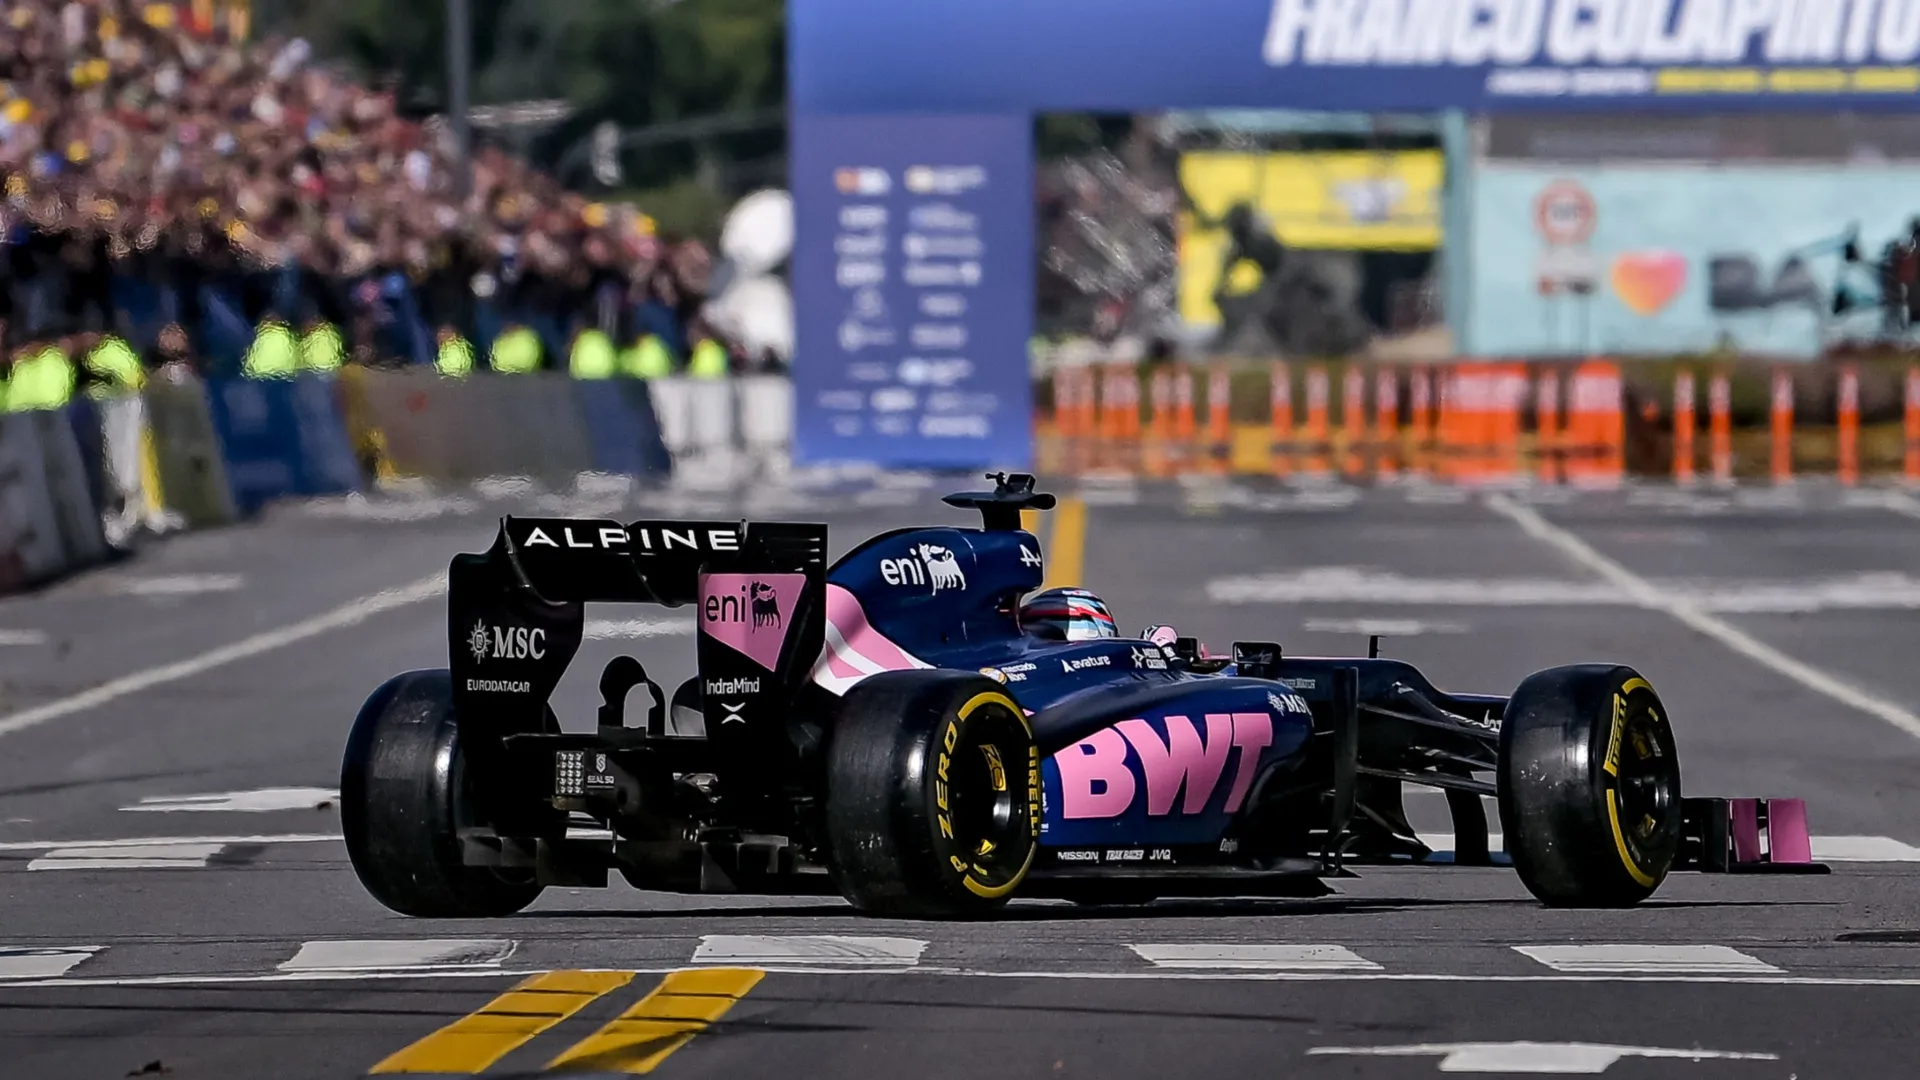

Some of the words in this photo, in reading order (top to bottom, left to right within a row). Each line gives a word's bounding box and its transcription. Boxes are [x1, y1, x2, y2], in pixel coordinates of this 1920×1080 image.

[523, 526, 740, 551] ALPINE
[880, 548, 925, 586] eni
[704, 584, 747, 624] eni
[492, 625, 546, 660] MSC
[1071, 655, 1111, 669] avature
[467, 679, 531, 693] EURODATACAR
[705, 676, 760, 695] IndraMind
[936, 721, 958, 840] ZERO
[1053, 712, 1273, 819] BWT
[1057, 851, 1099, 860] MISSION
